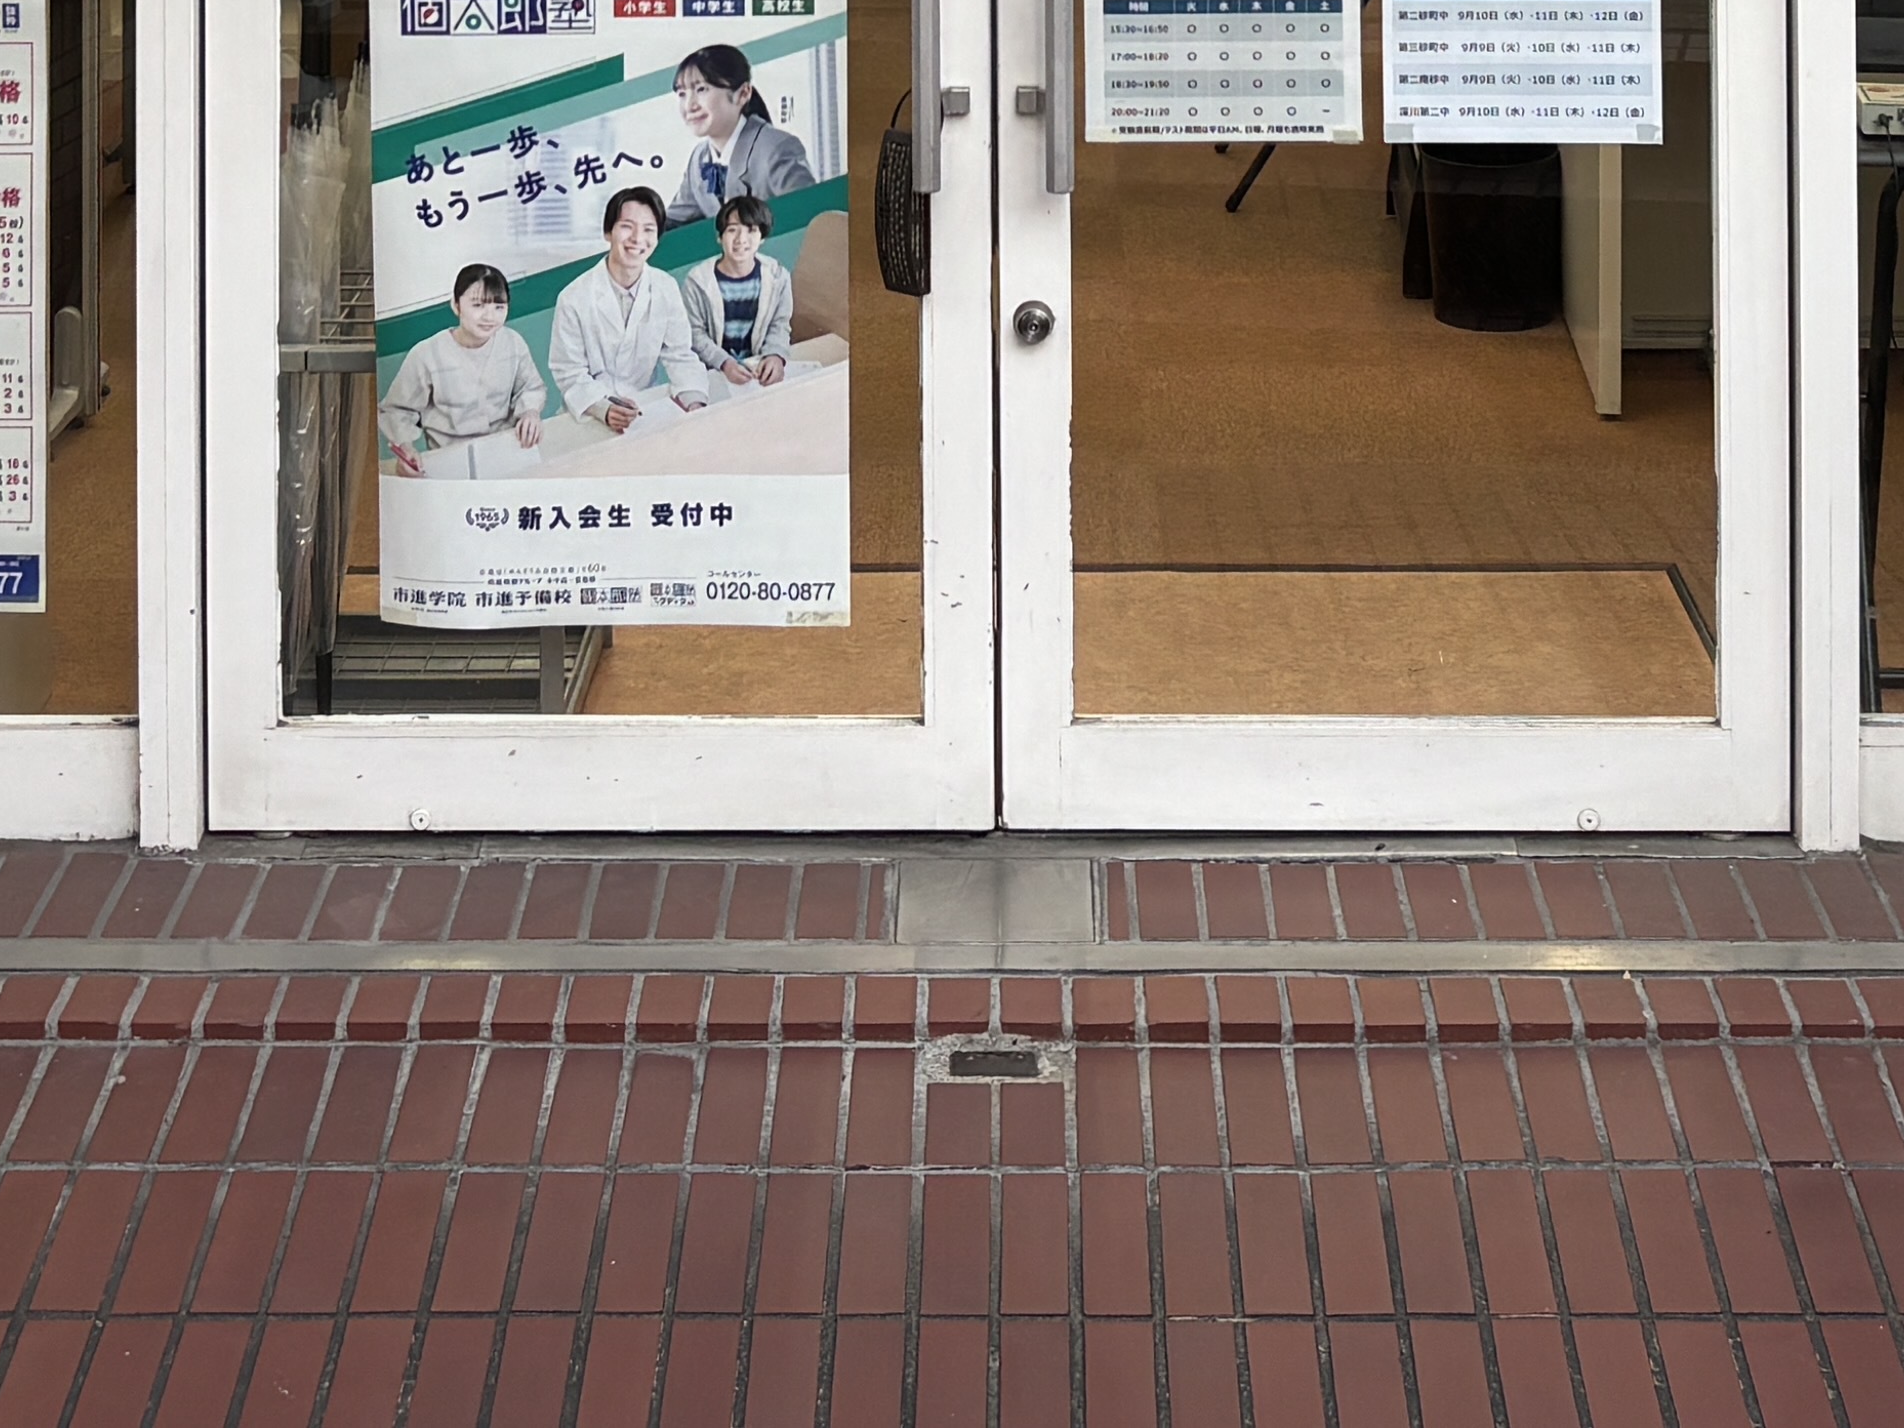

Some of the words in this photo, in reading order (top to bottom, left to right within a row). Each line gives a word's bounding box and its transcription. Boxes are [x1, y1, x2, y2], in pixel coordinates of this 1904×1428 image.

[623, 1, 667, 14] 小学生
[692, 1, 736, 14] 中学生
[761, 0, 806, 13] 高校生
[405, 124, 560, 185] あと一歩、
[415, 152, 664, 229] もう一歩、先へ。
[517, 503, 632, 530] 新入会生
[651, 503, 734, 528] 受付中
[706, 581, 835, 602] 0120-80-0877
